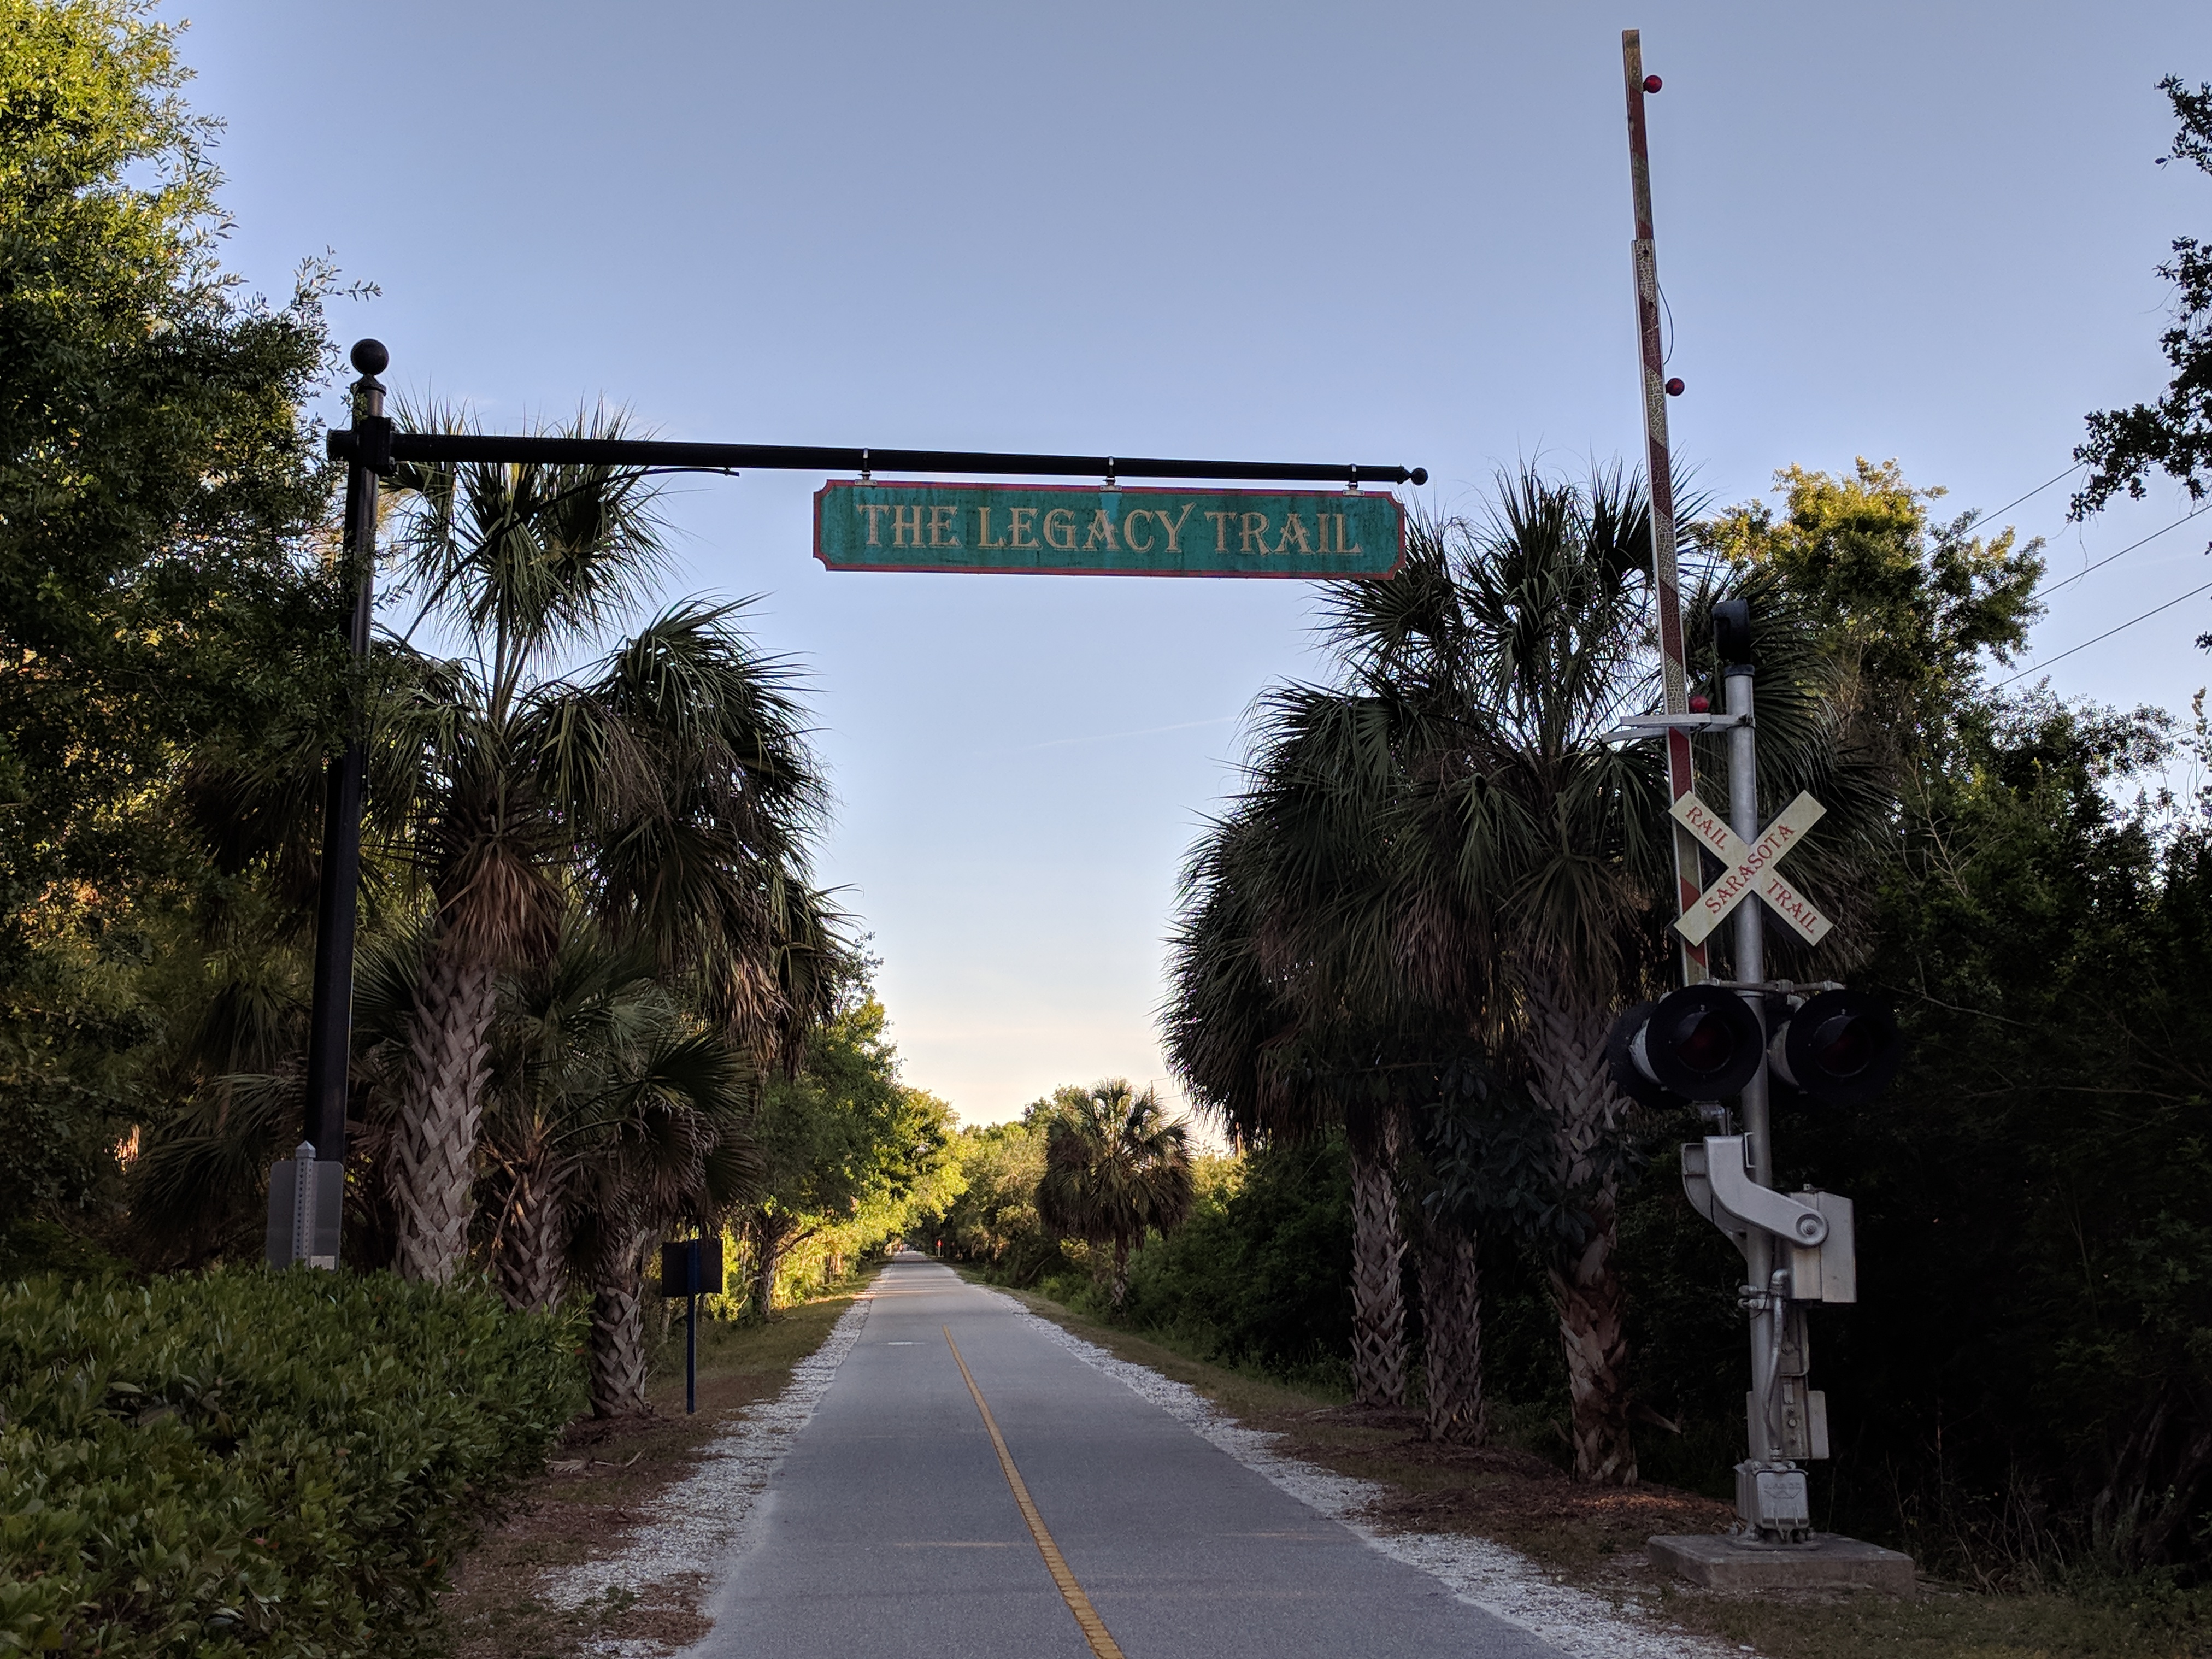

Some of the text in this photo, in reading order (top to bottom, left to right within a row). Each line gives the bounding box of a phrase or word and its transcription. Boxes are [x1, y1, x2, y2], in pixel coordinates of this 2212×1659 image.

[856, 502, 1363, 556] THE LEGACY TRAIL
[1686, 806, 1818, 934] RAIL TRAIL
[1704, 824, 1796, 914] SARASOTA
